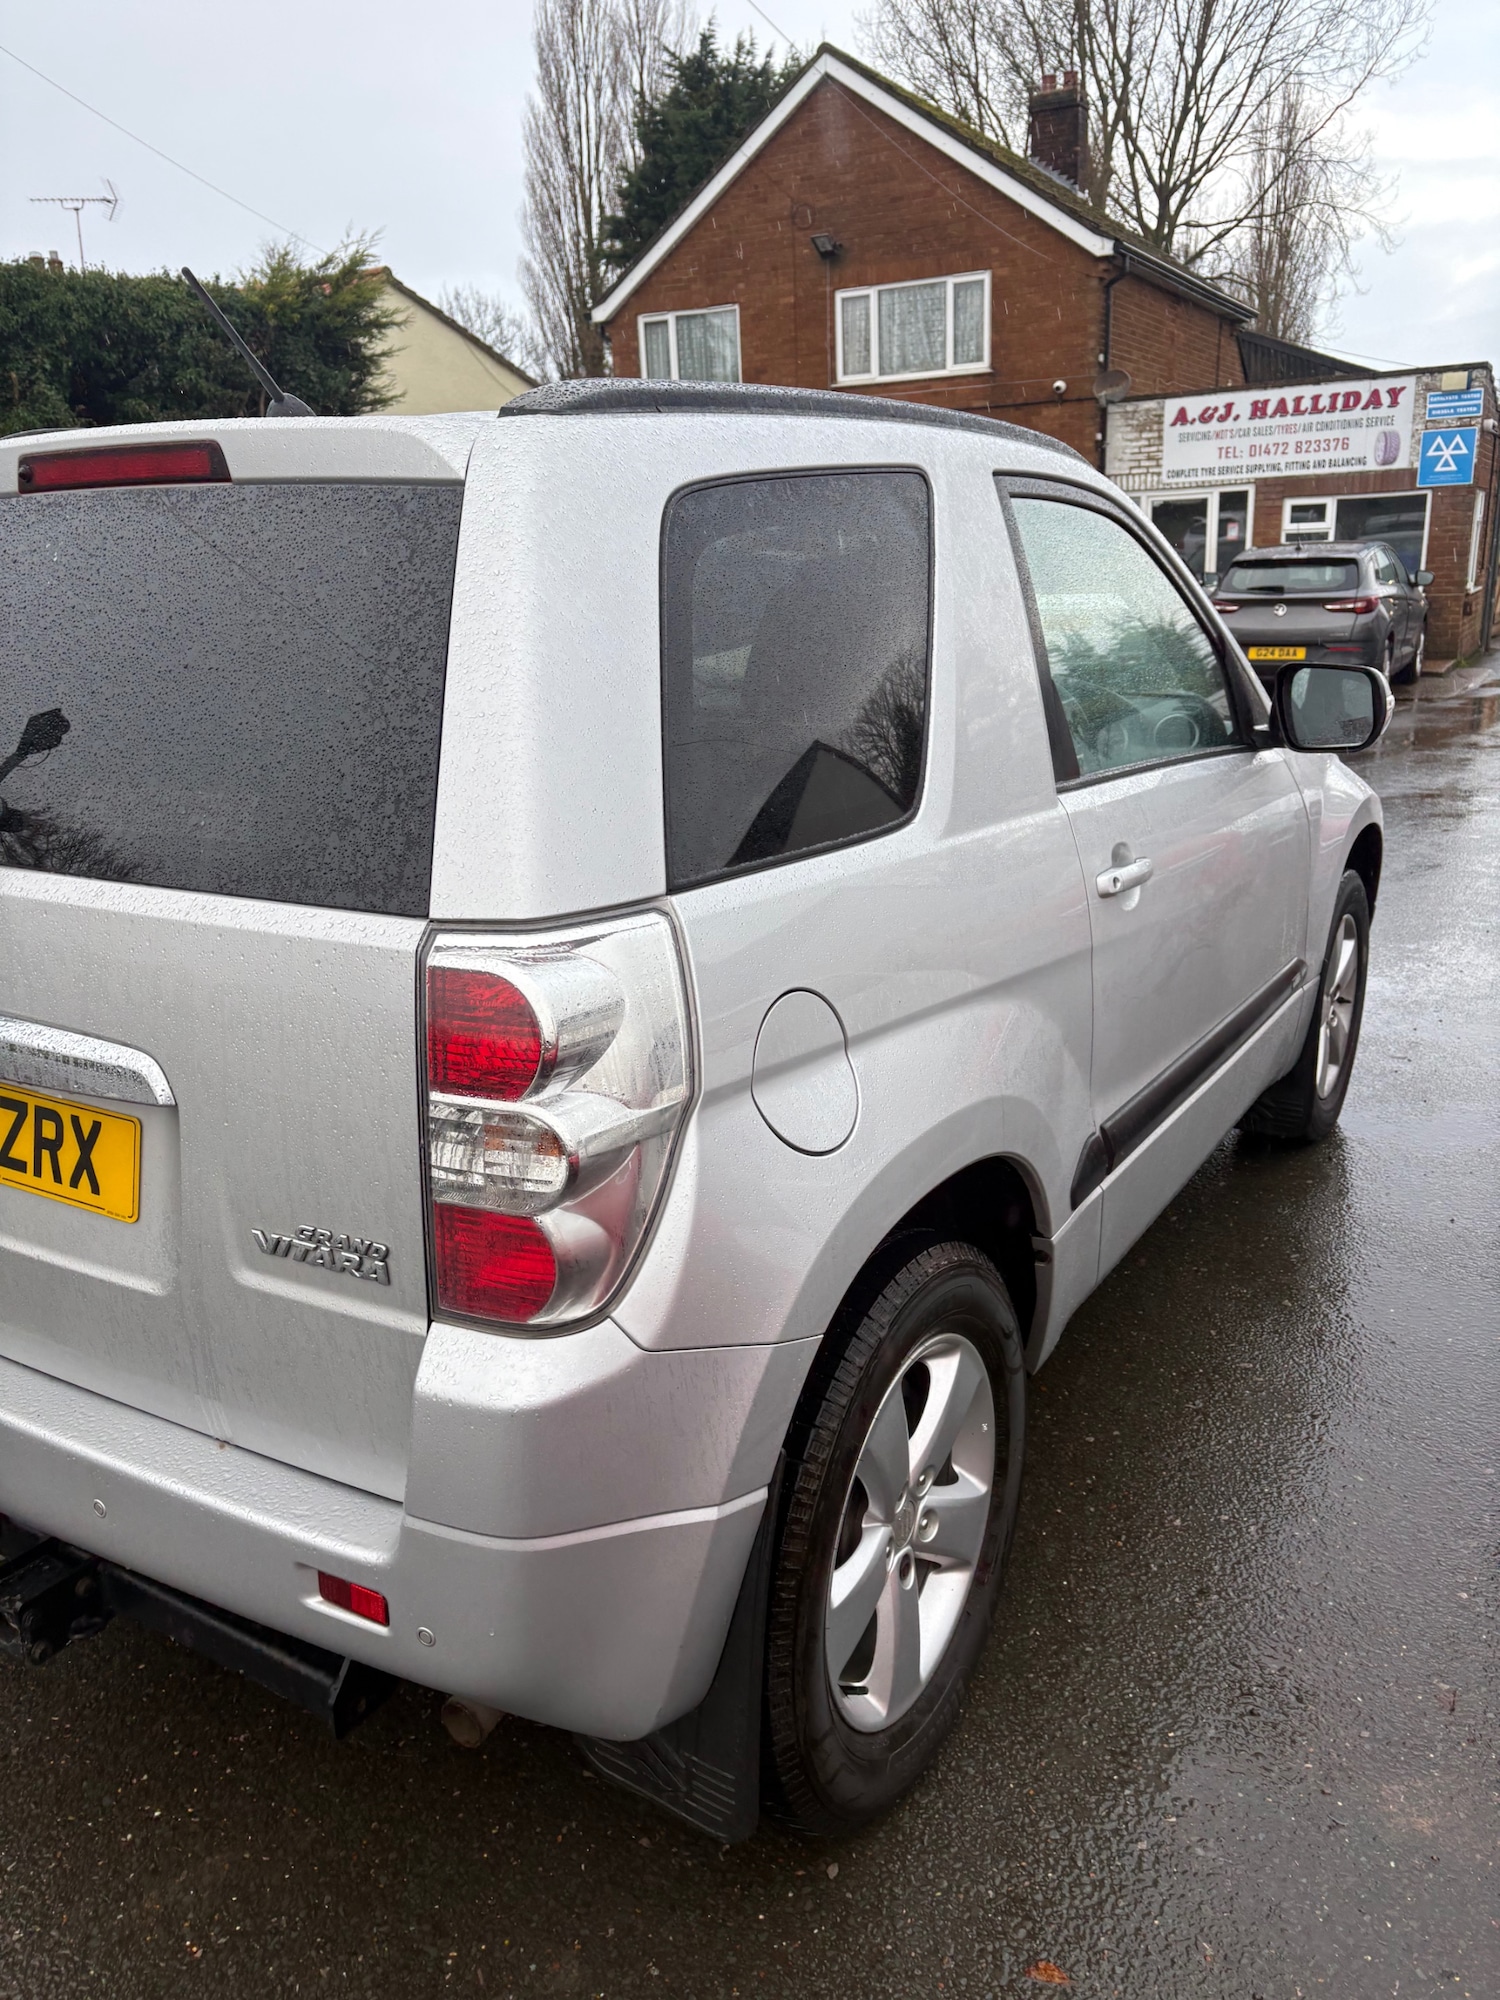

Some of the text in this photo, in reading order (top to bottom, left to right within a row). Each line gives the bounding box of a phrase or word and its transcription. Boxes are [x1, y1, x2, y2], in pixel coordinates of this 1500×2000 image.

[1248, 386, 1407, 420] HALLIDAY
[1315, 417, 1364, 432] CONDITIONING
[1366, 415, 1395, 428] SERVICE
[1217, 437, 1350, 459] TEL: 01472 823376
[1167, 456, 1368, 479] COMPLETE TYRE SERVICE SUPPLYING, FITTING AND BALANCING
[1256, 647, 1275, 657] G24
[0, 1096, 102, 1196] ZRX
[295, 1223, 390, 1261] GRAND
[251, 1228, 391, 1286] VITARA
